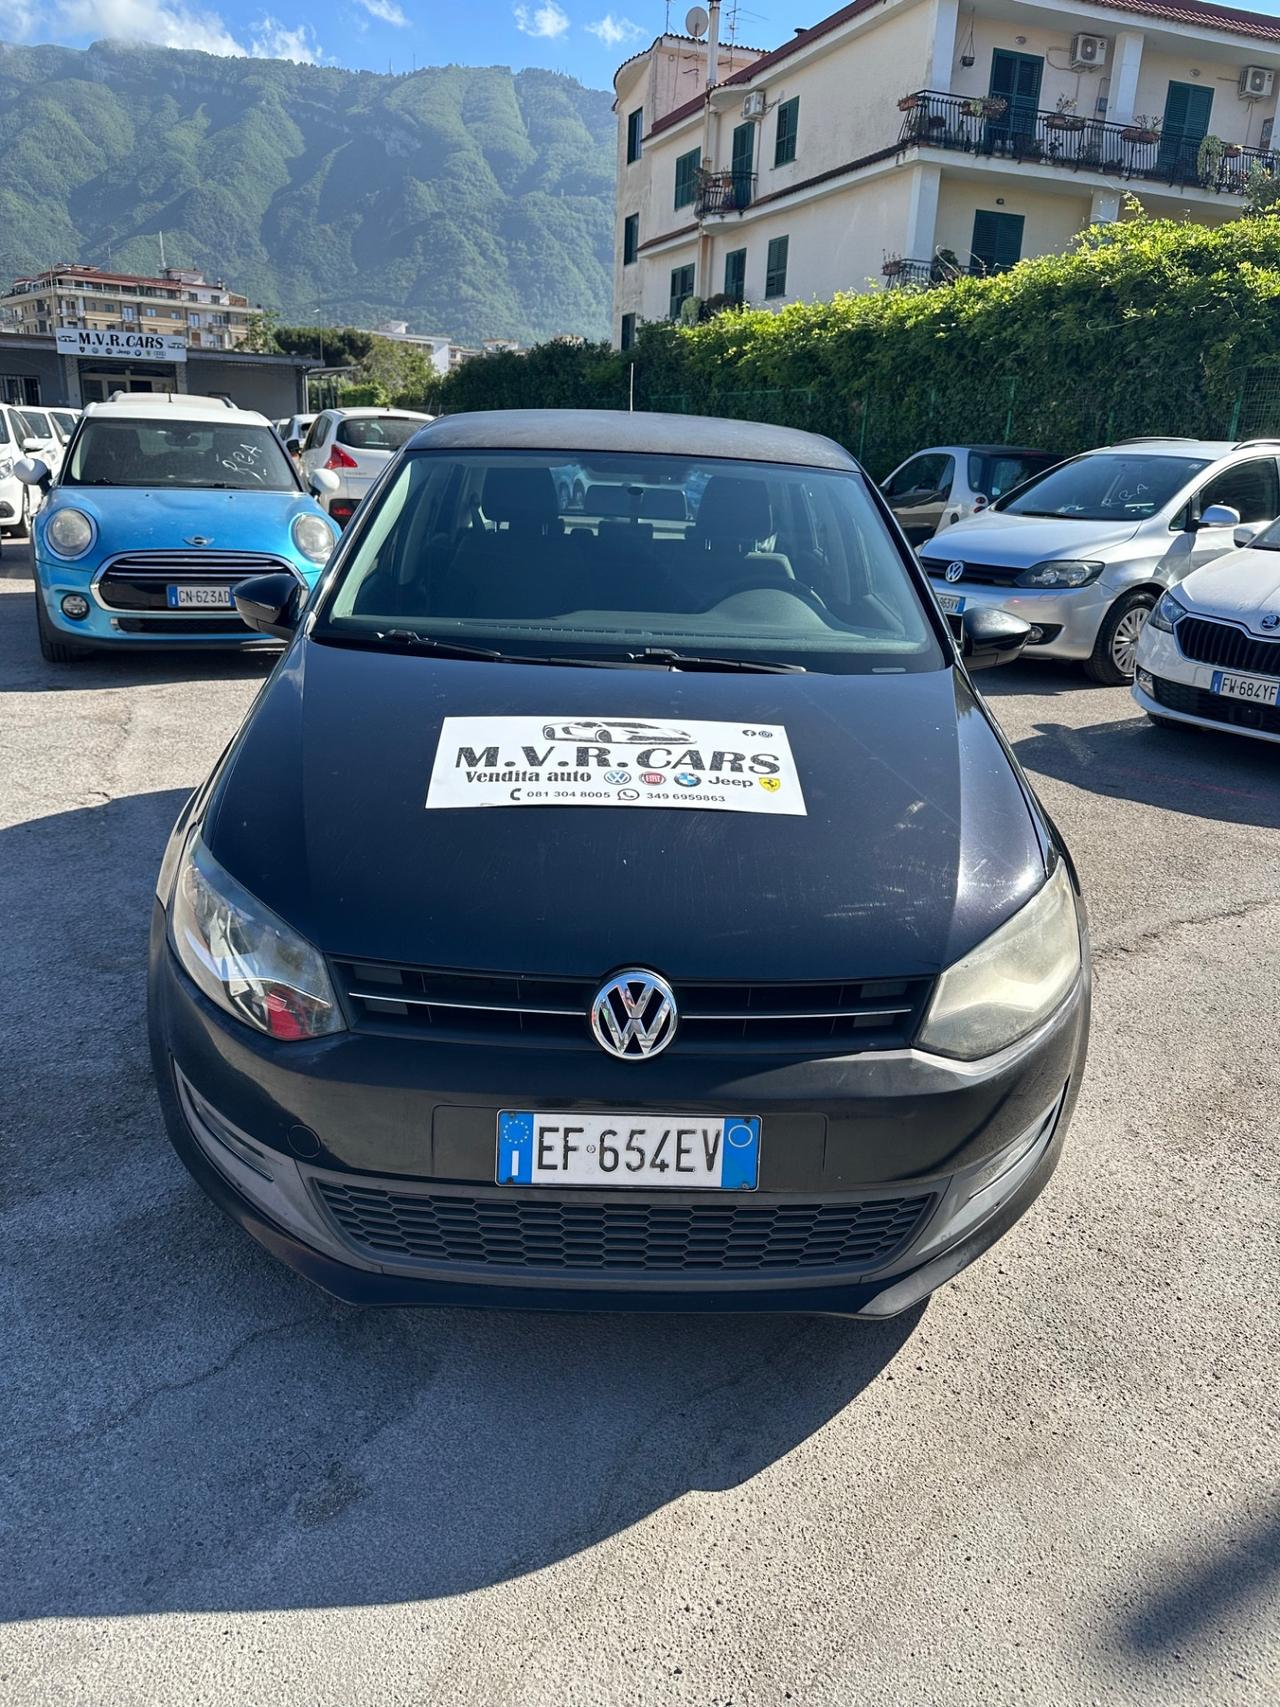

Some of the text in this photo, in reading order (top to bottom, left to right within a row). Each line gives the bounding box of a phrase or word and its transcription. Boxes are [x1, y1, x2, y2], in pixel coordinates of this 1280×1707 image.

[465, 770, 540, 783] Vendita
[547, 770, 592, 782] auto
[708, 776, 753, 788] Jeep
[580, 791, 611, 799] 8005
[647, 792, 669, 800] 349
